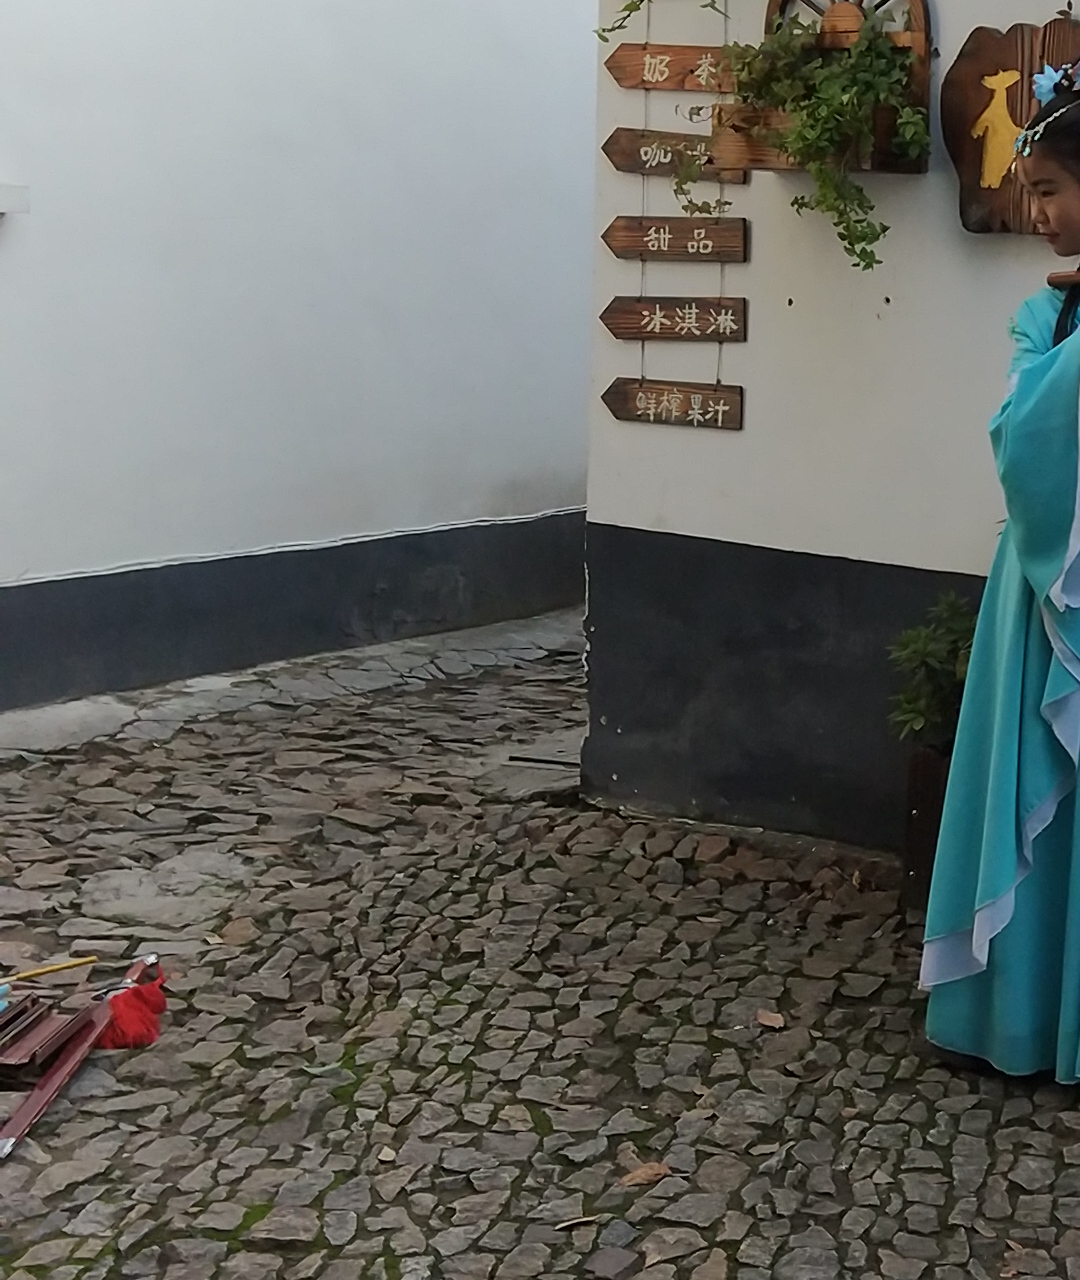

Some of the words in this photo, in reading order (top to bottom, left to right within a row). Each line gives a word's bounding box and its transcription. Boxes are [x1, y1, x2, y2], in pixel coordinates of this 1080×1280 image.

[642, 53, 717, 85] 奶茶
[643, 226, 714, 253] 甜品
[641, 303, 739, 336] 冰淇淋
[636, 388, 730, 427] 鲜榨果汁
